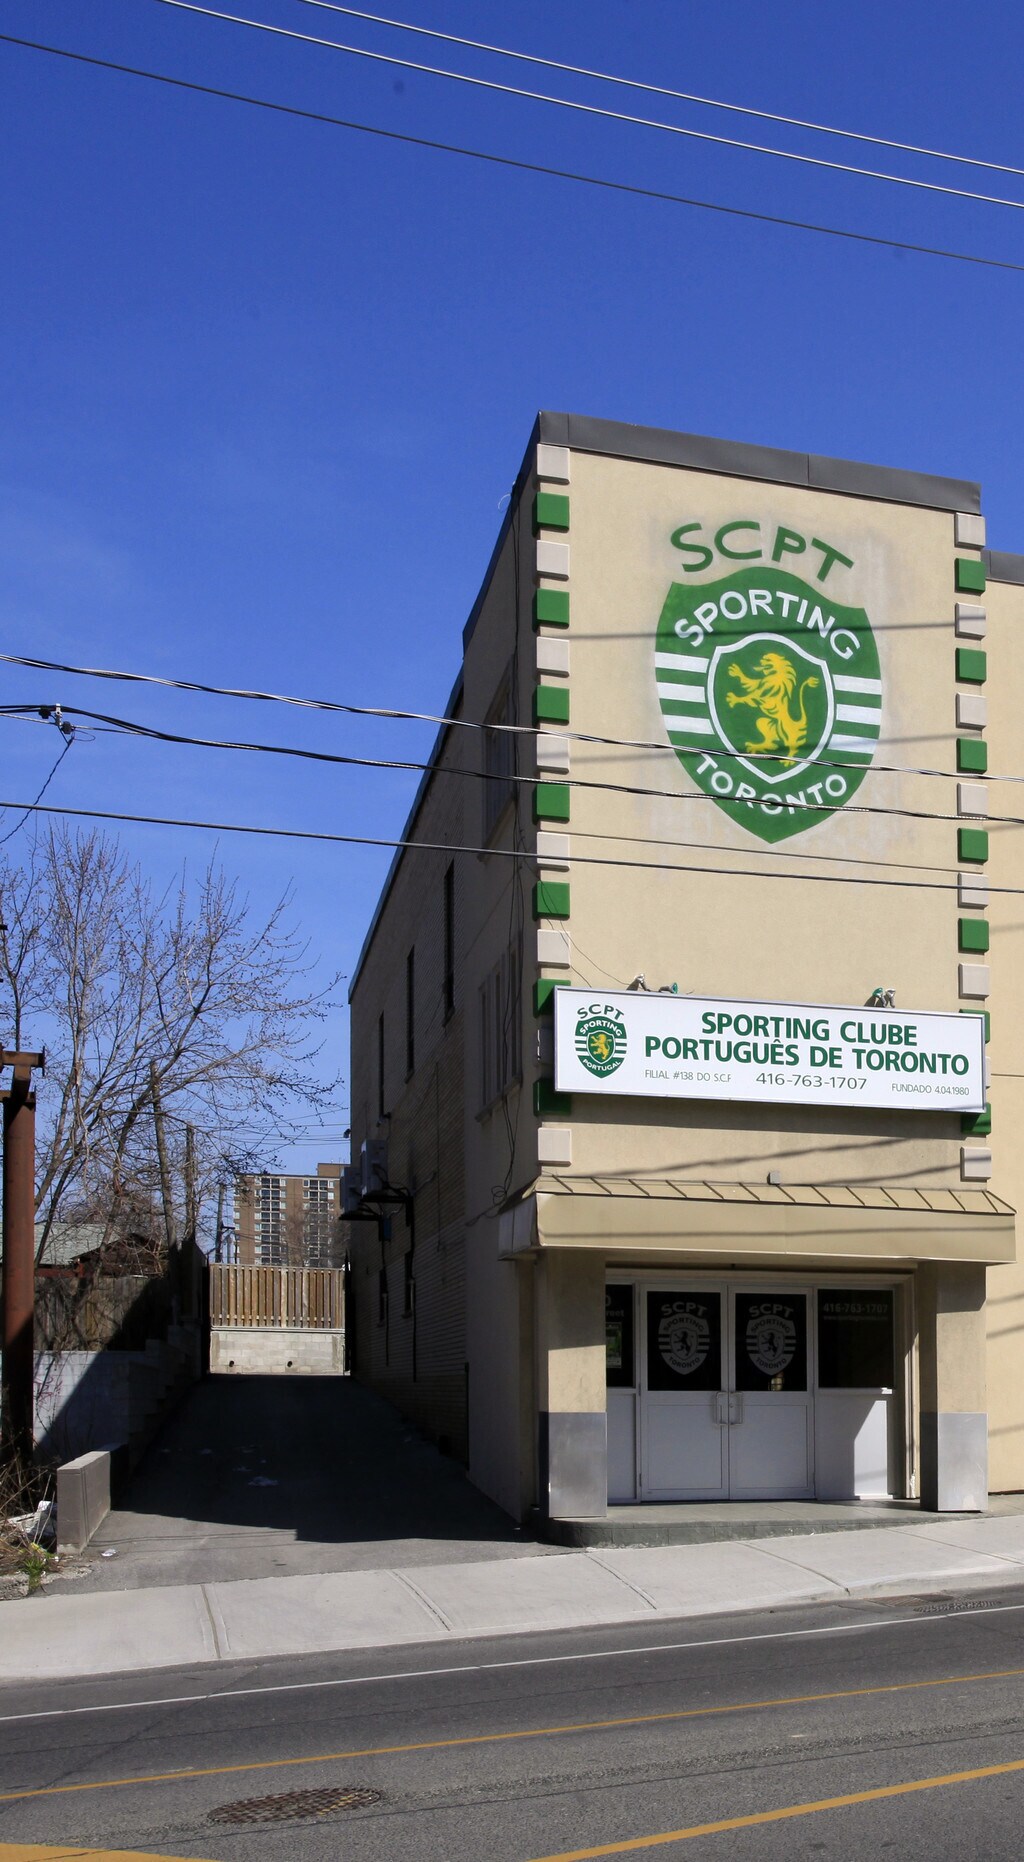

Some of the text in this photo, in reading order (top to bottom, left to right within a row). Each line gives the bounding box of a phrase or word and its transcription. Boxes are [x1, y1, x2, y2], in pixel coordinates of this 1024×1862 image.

[670, 520, 854, 582] SCPT
[674, 589, 861, 660] SPORTING
[696, 752, 847, 815] TORONTO
[577, 1003, 625, 1020] SCPT
[579, 1020, 622, 1036] SPORTING
[702, 1012, 917, 1046] SPORTING CLUBE
[645, 1036, 969, 1075] PORTUGUÊS DE TORONTO
[583, 1059, 621, 1071] PORTUGAL
[645, 1069, 669, 1079] FILIAL
[673, 1071, 694, 1081] #138
[696, 1072, 711, 1082] DO
[755, 1072, 867, 1090] 416-763-1707
[892, 1083, 932, 1093] FUNDADO
[660, 1301, 708, 1316] SCPT
[749, 1303, 794, 1318] SCPT
[823, 1303, 888, 1313] 416-763-1707
[663, 1317, 705, 1332] SPORTING
[751, 1319, 790, 1333] SPORTING
[669, 1356, 700, 1368] TORONTO
[756, 1357, 787, 1369] TORONTO
